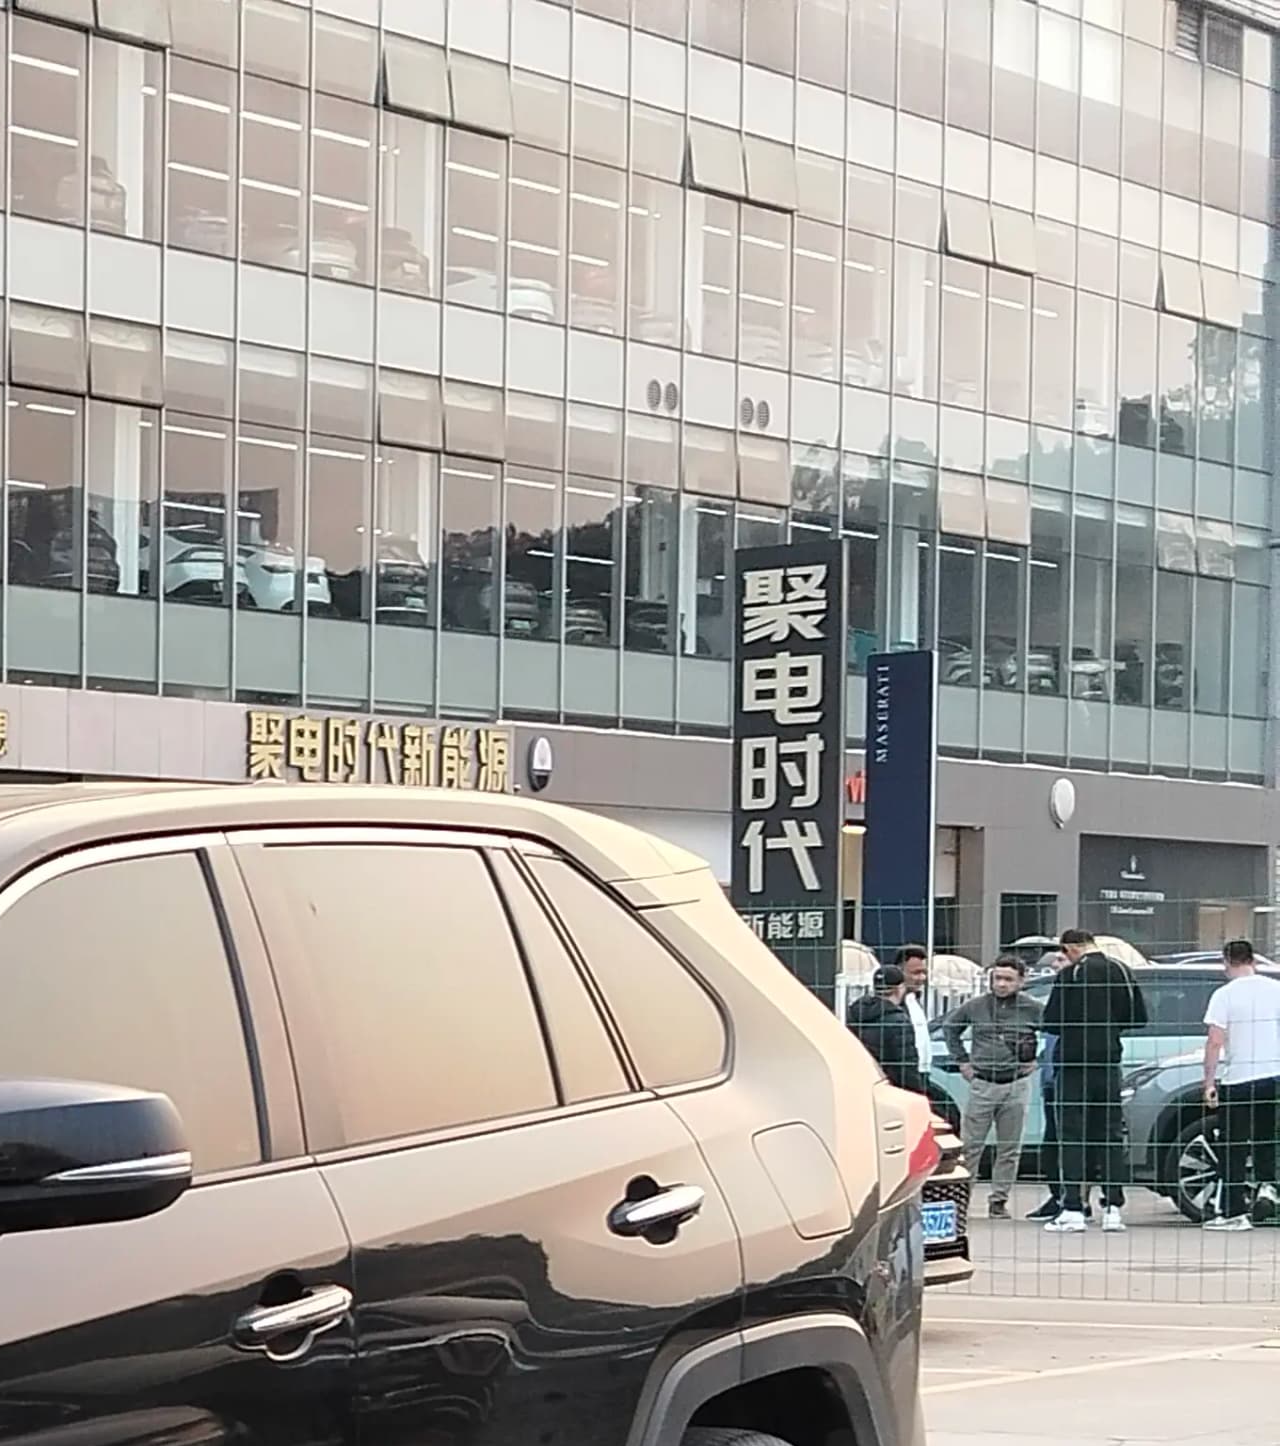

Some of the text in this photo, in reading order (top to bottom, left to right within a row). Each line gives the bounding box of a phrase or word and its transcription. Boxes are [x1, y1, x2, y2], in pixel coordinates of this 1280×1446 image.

[247, 710, 511, 793] 聚电时代新能源
[741, 563, 829, 894] 聚电时代
[874, 664, 890, 763] MASERATI
